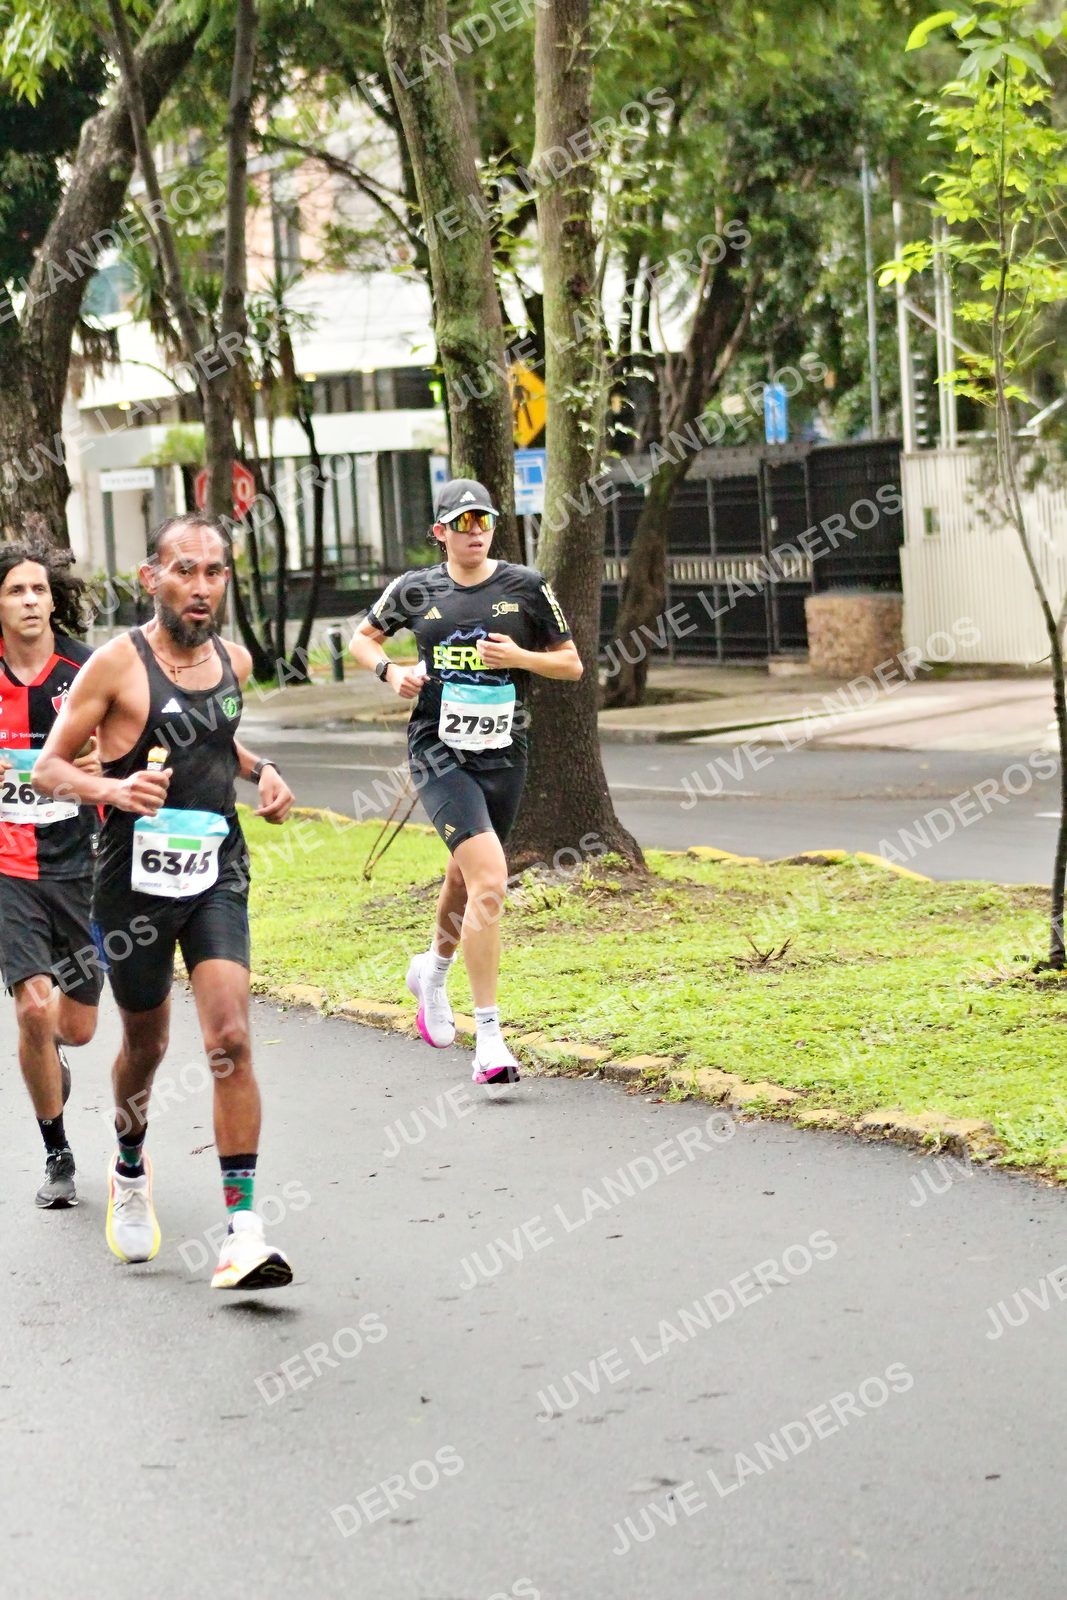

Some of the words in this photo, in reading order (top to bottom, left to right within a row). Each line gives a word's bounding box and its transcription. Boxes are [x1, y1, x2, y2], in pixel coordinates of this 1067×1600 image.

[433, 645, 490, 670] BERL
[445, 713, 509, 735] 2795
[141, 849, 213, 876] 6345
